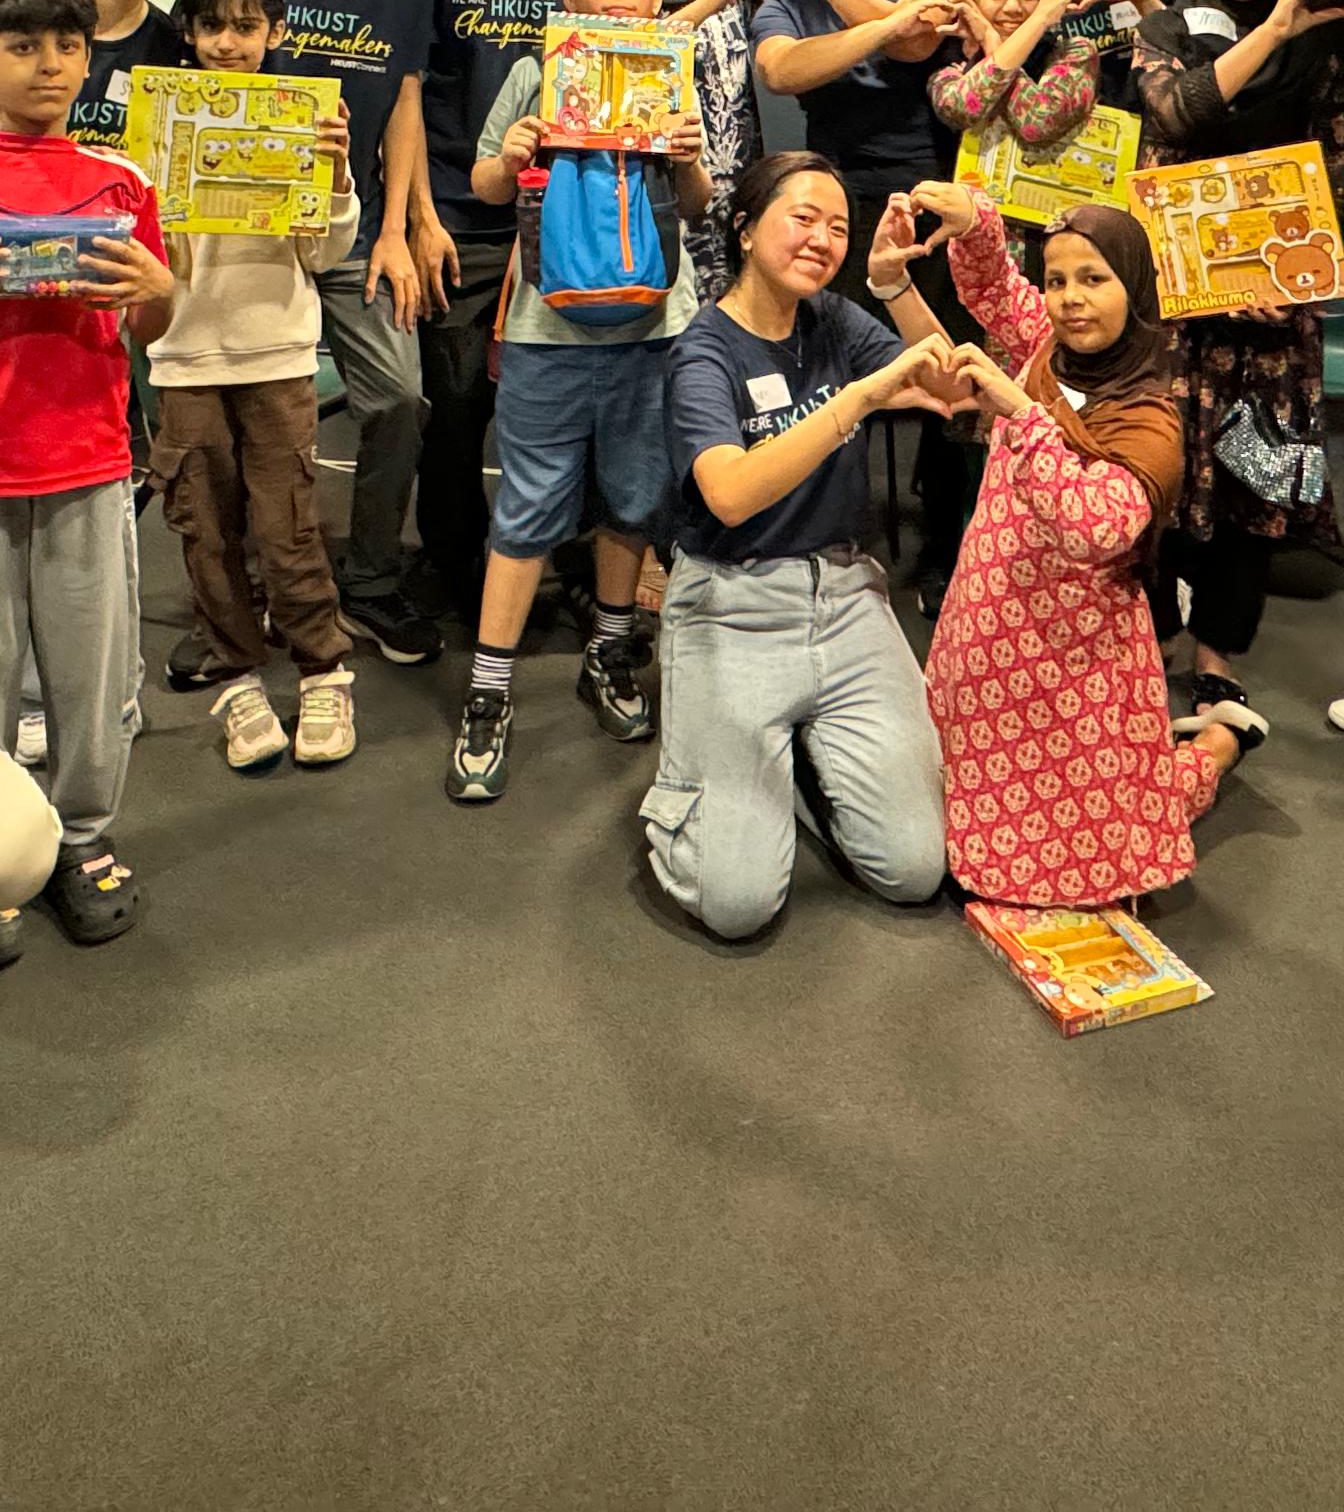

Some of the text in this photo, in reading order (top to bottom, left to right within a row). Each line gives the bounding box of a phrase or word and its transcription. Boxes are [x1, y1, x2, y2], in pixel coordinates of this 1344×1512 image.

[286, 4, 360, 33] HKUST
[1066, 10, 1112, 38] HKUS
[284, 24, 394, 59] ngemakers
[1163, 289, 1256, 313] Rilakkuma
